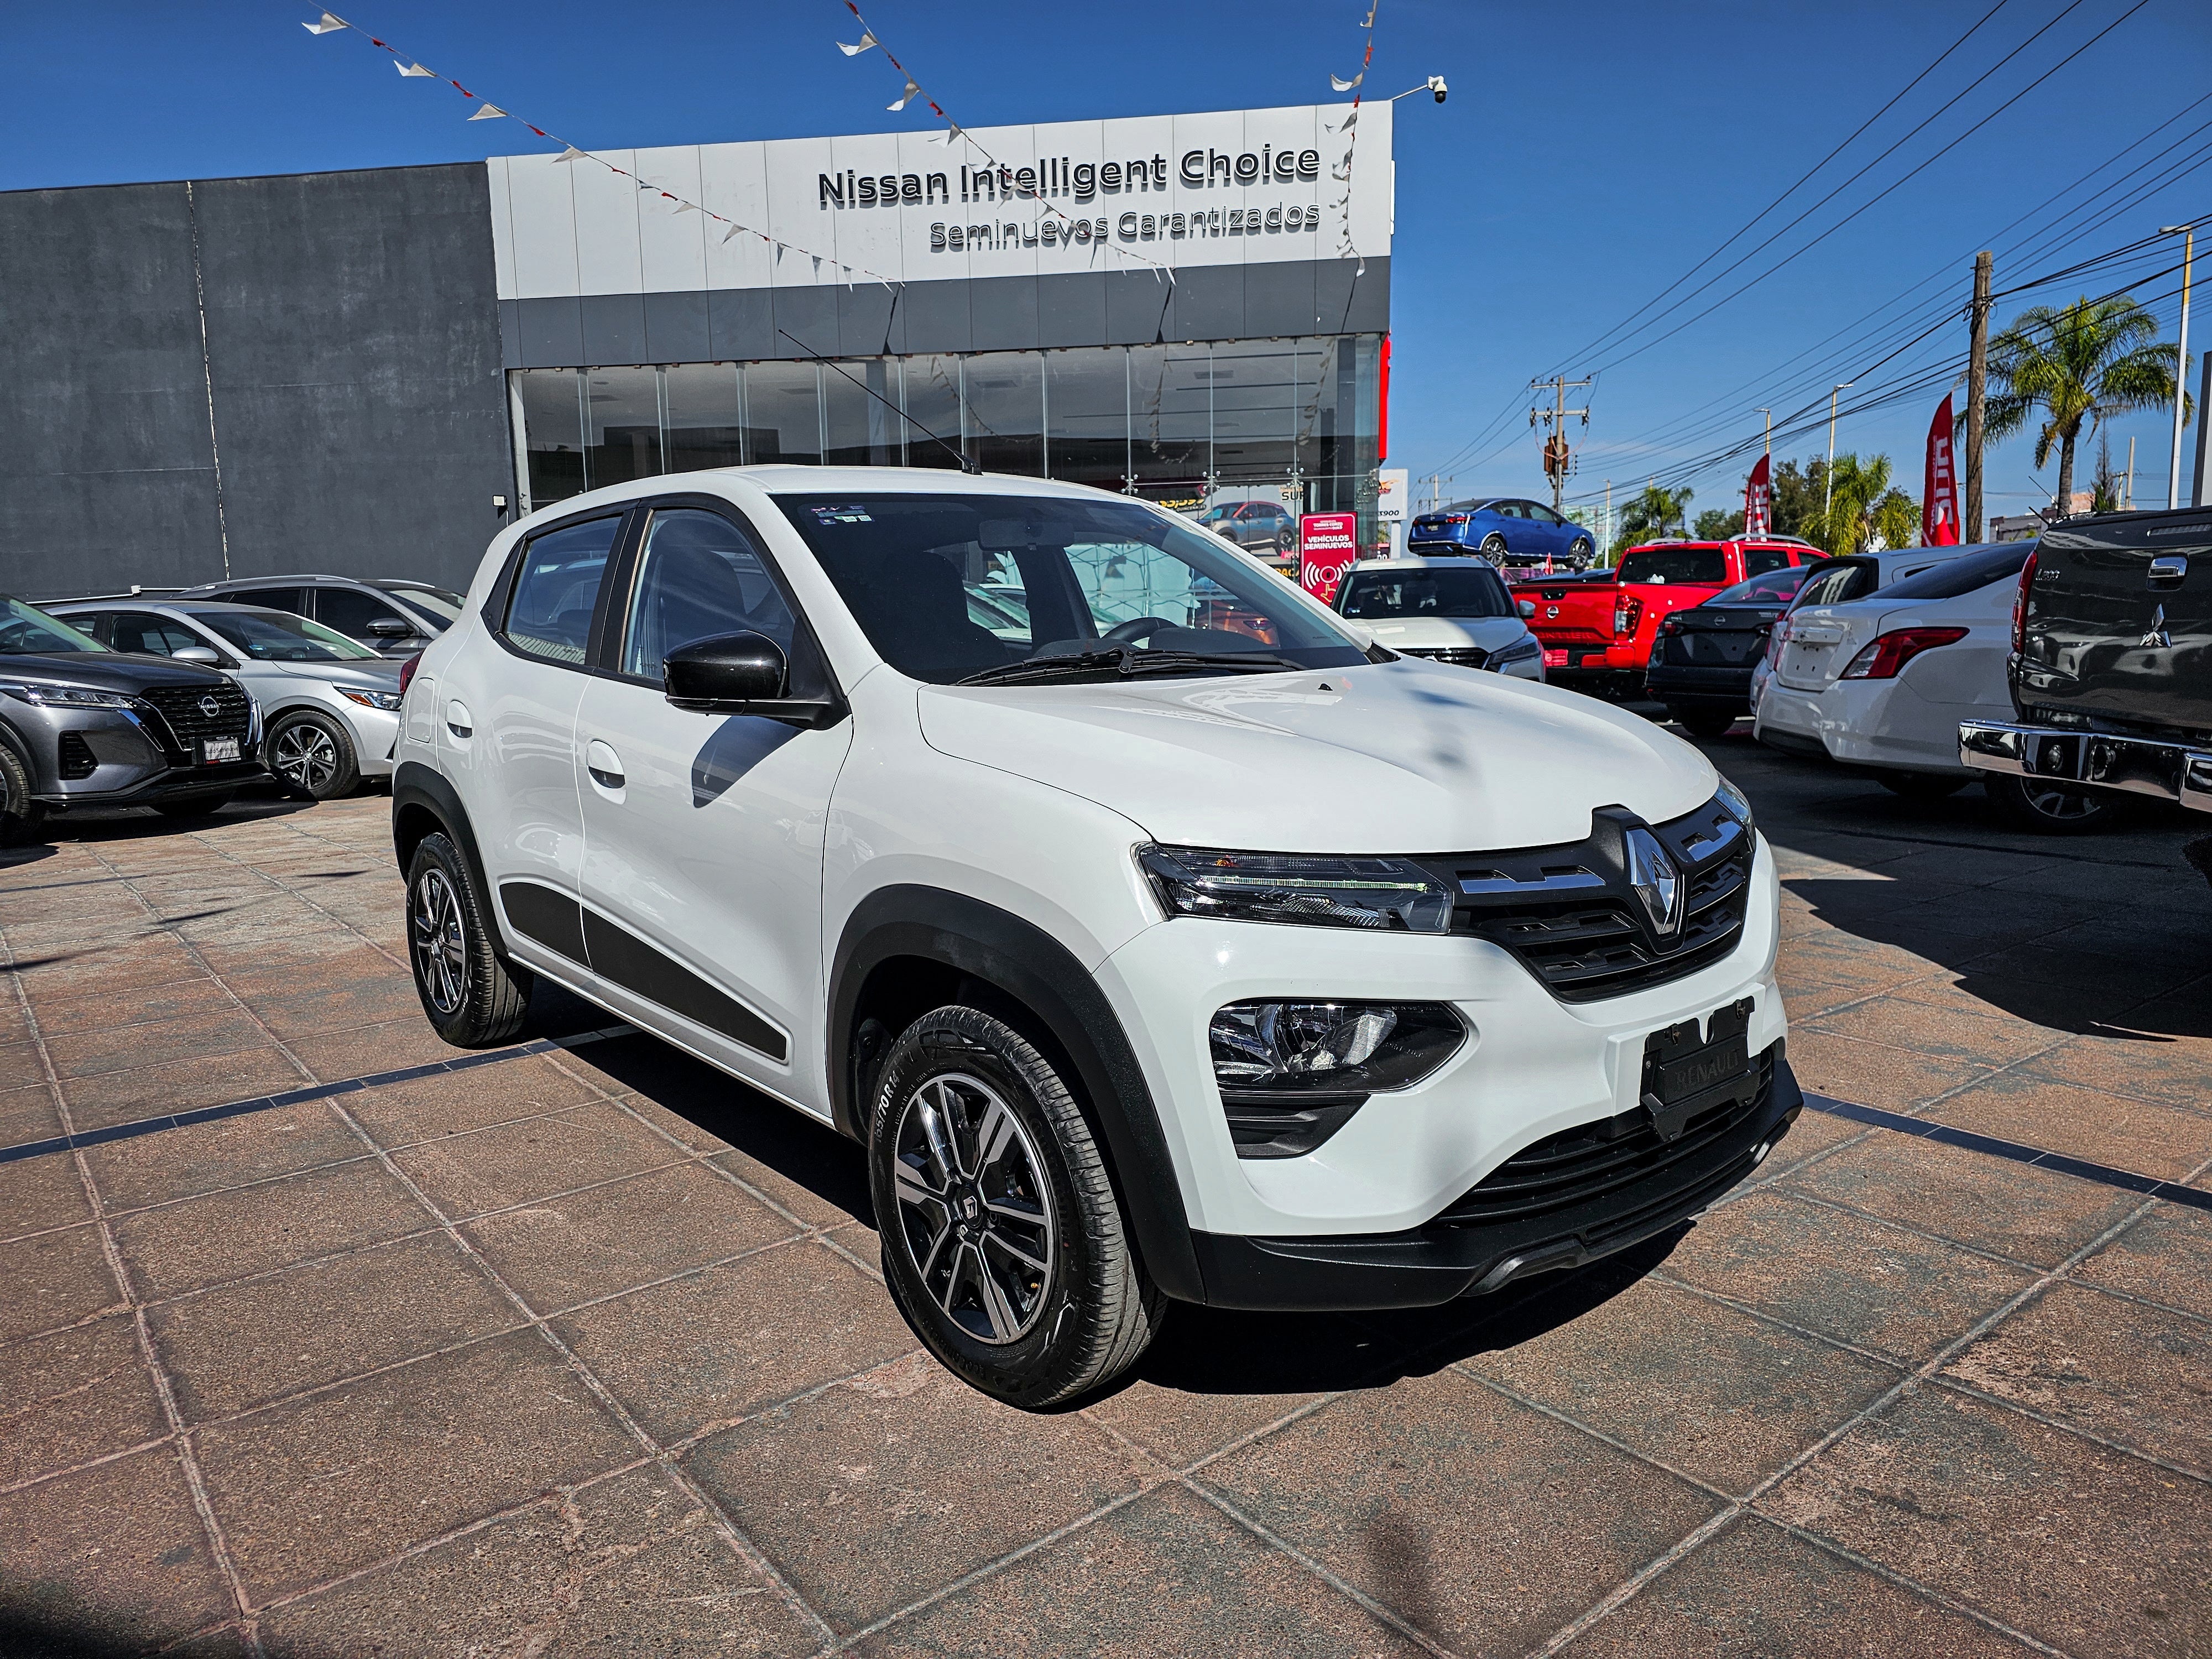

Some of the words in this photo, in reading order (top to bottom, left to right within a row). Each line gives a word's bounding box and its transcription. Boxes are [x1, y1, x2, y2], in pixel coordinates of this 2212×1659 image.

[819, 169, 948, 202] Nissan
[961, 154, 1167, 196] Intelligent
[1180, 143, 1320, 180] Choice
[930, 217, 1108, 245] Seminuevos
[1118, 201, 1321, 236] Garantizados
[1304, 541, 1353, 550] SEMINUEVOS
[1307, 535, 1350, 543] VEHÍCULOS
[1675, 1048, 1740, 1090] RENAULT
